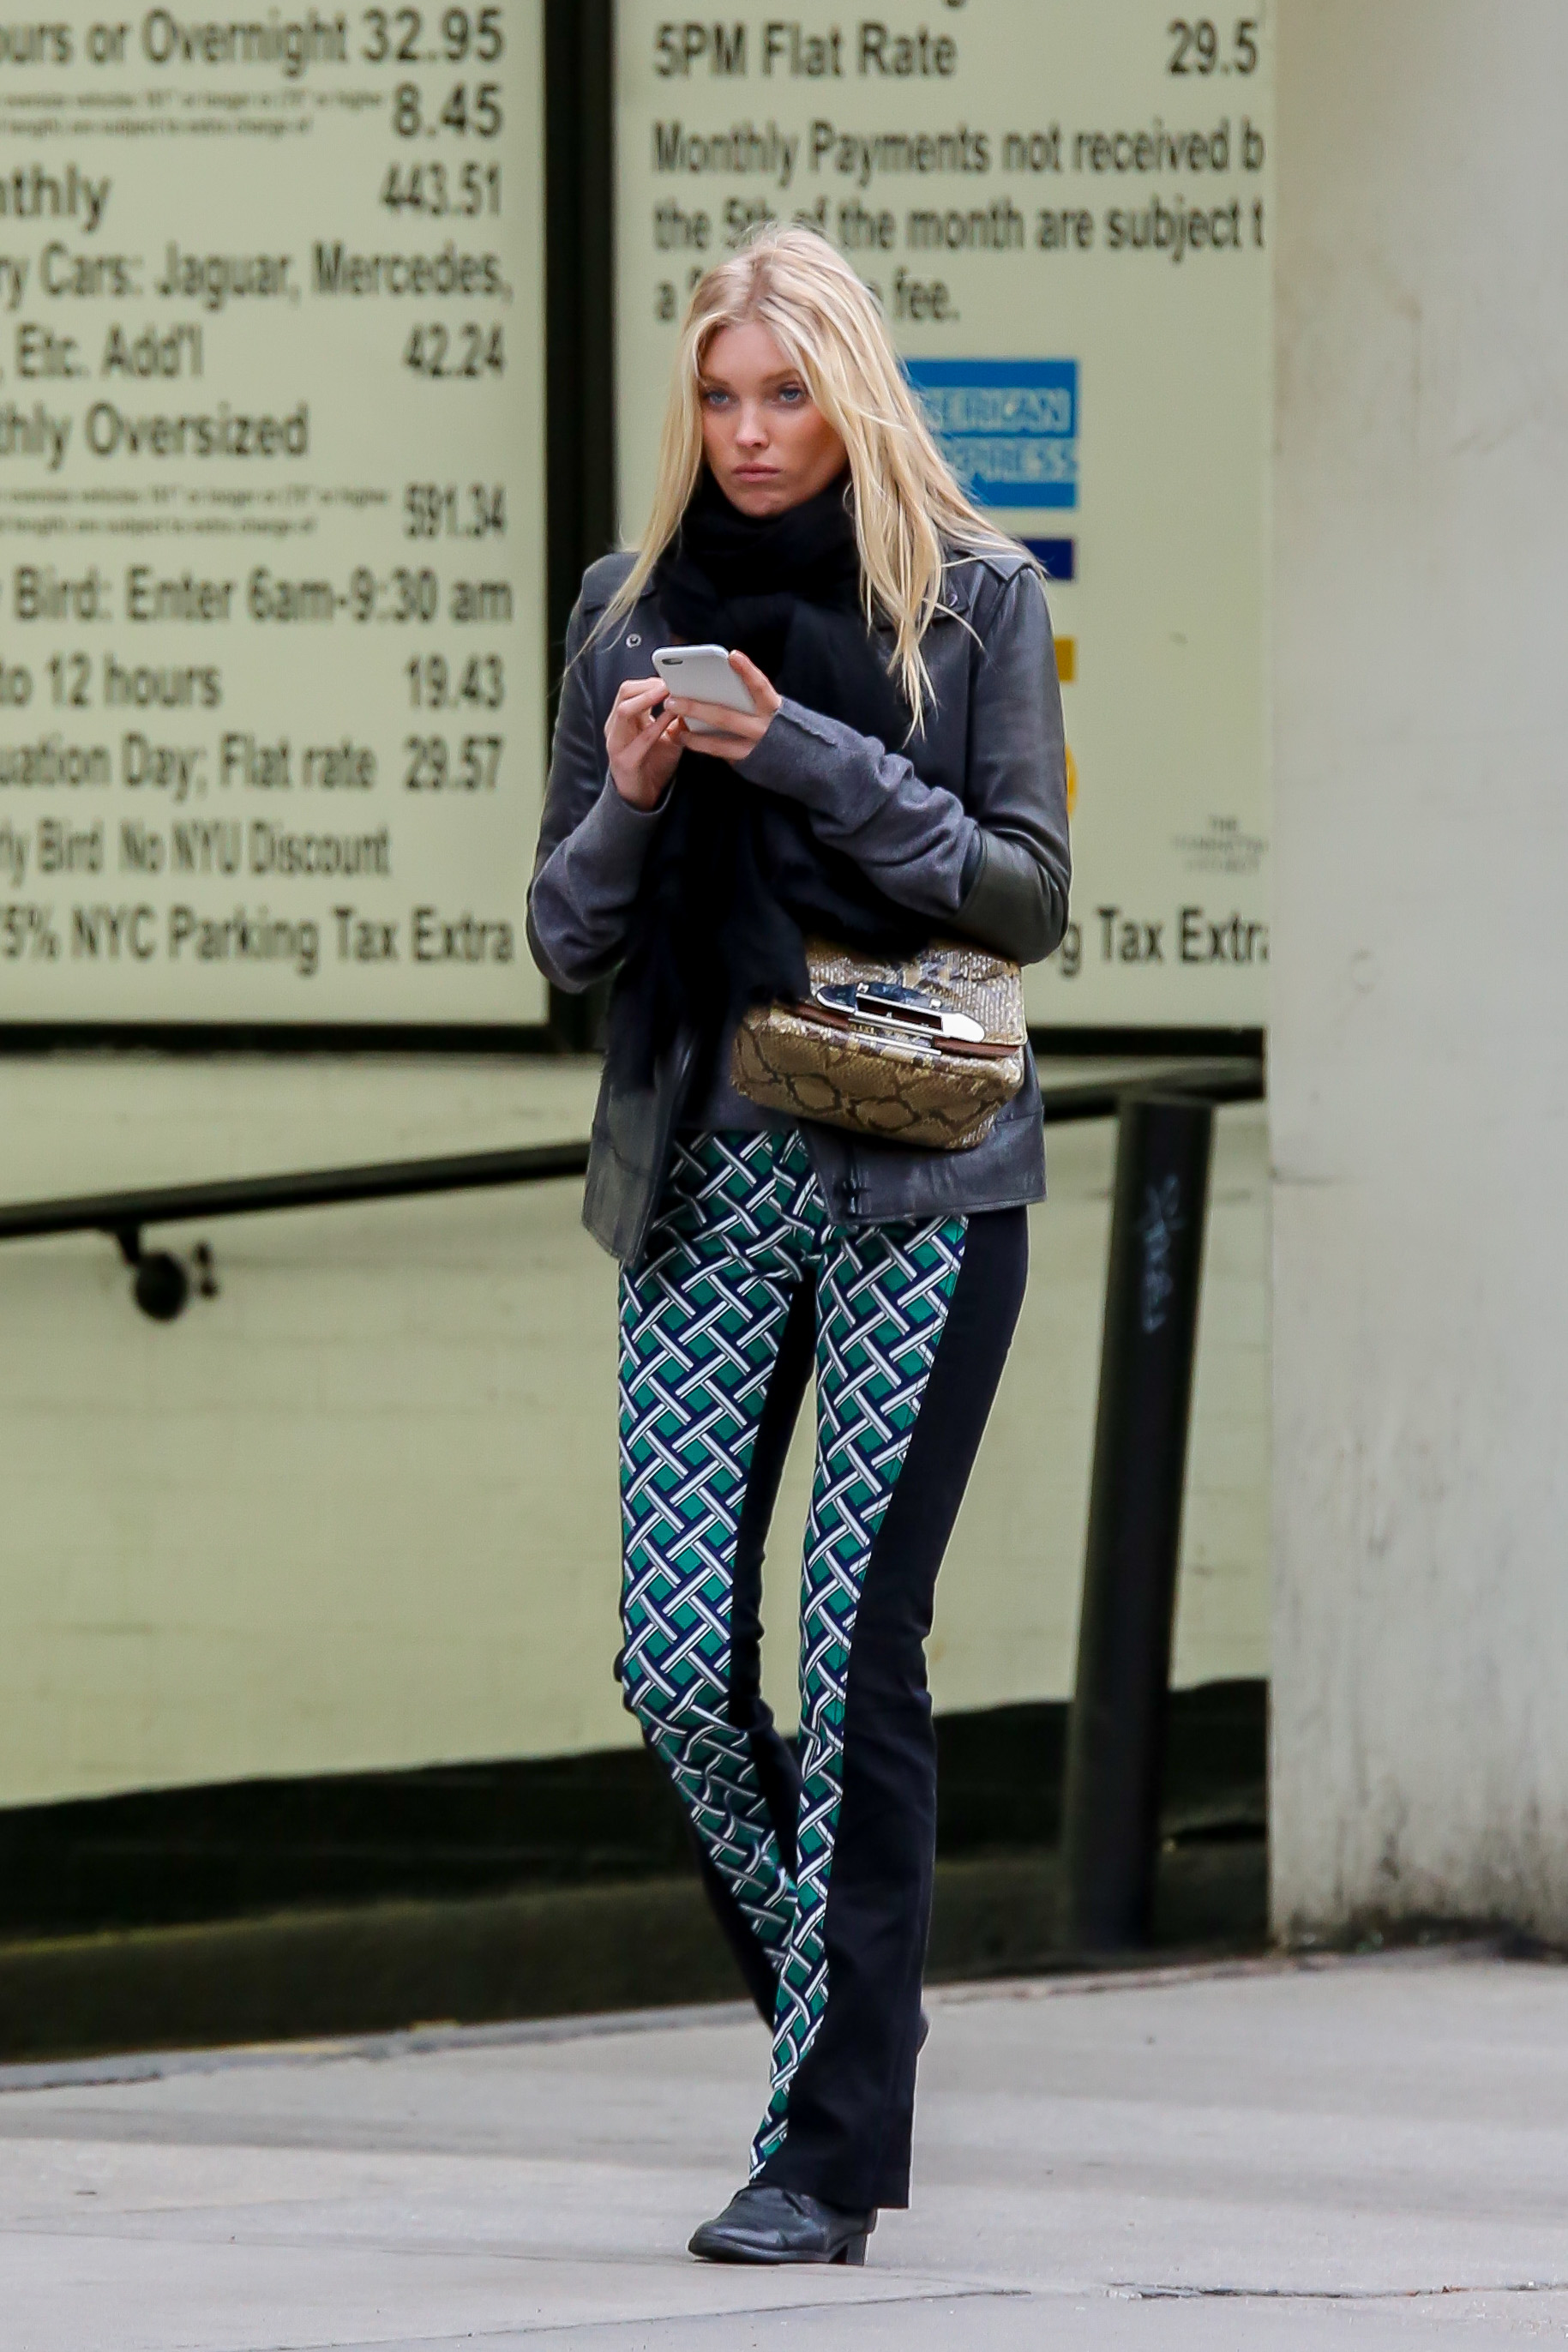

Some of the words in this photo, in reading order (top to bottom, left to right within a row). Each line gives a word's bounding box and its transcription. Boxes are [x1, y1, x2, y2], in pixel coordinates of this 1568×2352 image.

[85, 21, 131, 67] or
[141, 6, 349, 79] Overnight
[359, 7, 504, 63] 32.95
[652, 21, 748, 78] 5PM
[760, 21, 844, 77] Flat
[856, 21, 958, 77] Rate
[393, 81, 504, 140] 8.45
[650, 118, 799, 187] Monthly
[808, 118, 992, 187] Payments
[1001, 120, 1064, 173] not
[1071, 117, 1231, 174] received
[378, 162, 503, 218] 443.51
[652, 196, 712, 251] the
[836, 195, 897, 251] the
[905, 195, 1026, 250] month
[1033, 208, 1096, 251] are
[1102, 195, 1241, 262] subject
[39, 239, 143, 297] Cars:
[154, 241, 301, 311] Jaguar,
[310, 238, 514, 302] Mercedes,
[654, 280, 677, 322] a
[892, 265, 959, 321] fee.
[15, 322, 89, 379] Etc.
[400, 323, 504, 377] 42.24
[84, 400, 310, 459] Oversized
[405, 483, 508, 540] 591.34
[124, 563, 237, 623] Enter
[246, 565, 440, 624] 6am-9:30
[449, 580, 514, 623] am
[45, 652, 92, 709] 12
[103, 653, 223, 710] hours
[403, 653, 506, 710] 19.43
[219, 731, 294, 791] Flat
[301, 737, 378, 791] rate
[402, 733, 506, 792] 29.57
[118, 818, 165, 875] No
[171, 818, 242, 876] NYU
[249, 818, 392, 878] Discount
[71, 903, 156, 963] NYC
[168, 904, 320, 977] Parking
[330, 905, 400, 963] Tax
[410, 905, 514, 965] Extra
[1096, 907, 1164, 964] Tax
